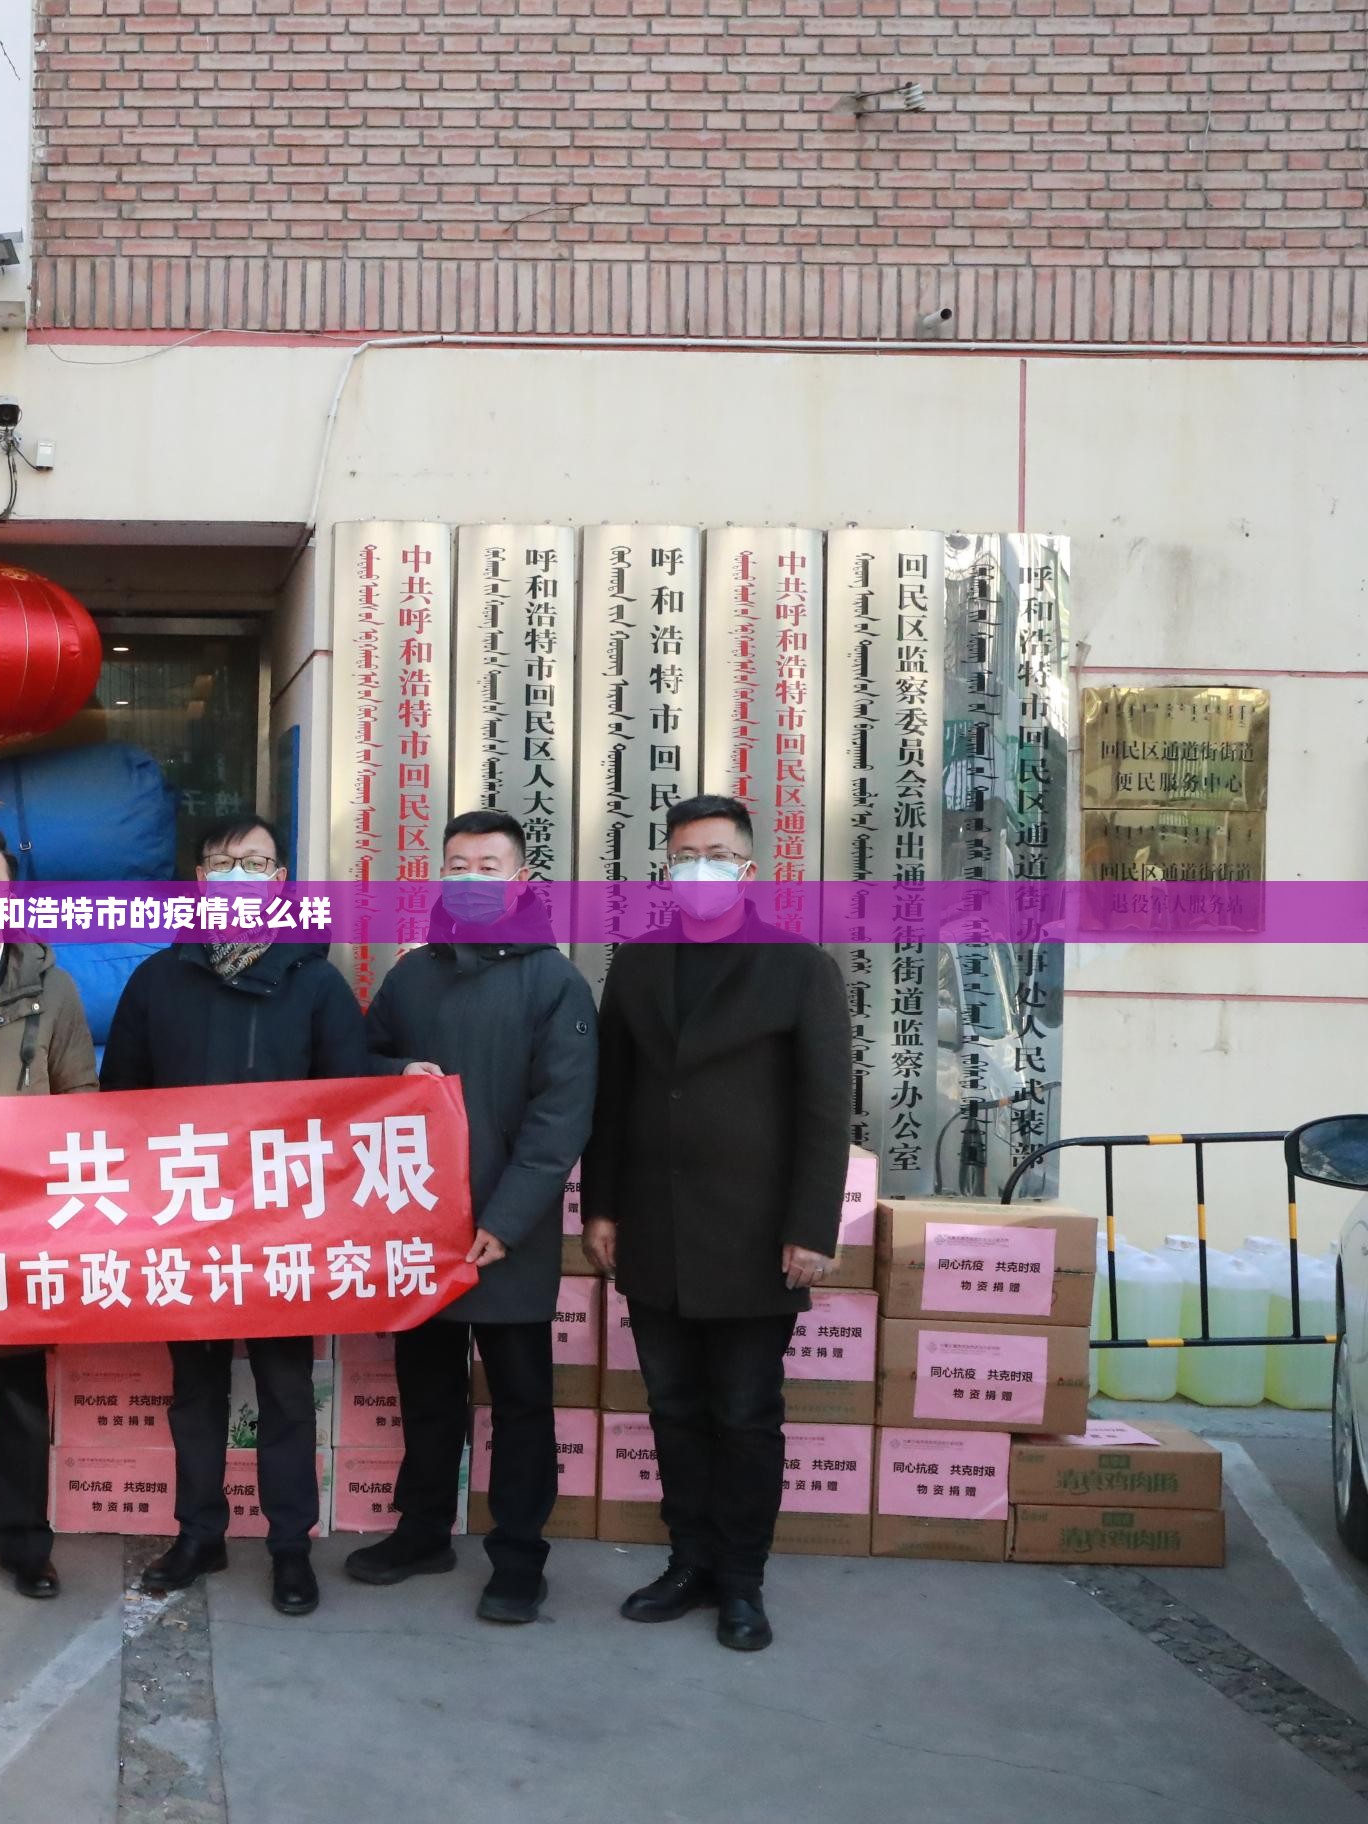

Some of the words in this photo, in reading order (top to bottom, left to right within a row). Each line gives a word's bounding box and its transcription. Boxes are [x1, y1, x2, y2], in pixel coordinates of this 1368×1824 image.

[1101, 740, 1255, 763] 回民区通道街街道
[1116, 771, 1243, 793] 便民服务中心
[888, 552, 929, 1171] 回民区监察委员会派出通道街街道监察办公室
[46, 1115, 440, 1230] 共克时艰
[938, 1258, 984, 1272] 同心抗疫
[995, 1261, 1041, 1274] 共克时艰
[961, 1280, 1021, 1293] 物资捐赠
[818, 1326, 862, 1338] 共克时艰
[930, 1366, 976, 1381] 同心抗疫
[987, 1368, 1033, 1382] 共克时艰
[74, 1394, 118, 1407] 同心抗疫
[353, 1395, 398, 1407] 同心抗疫
[953, 1388, 1013, 1402] 物资捐赠
[97, 1415, 155, 1427] 物资捐赠
[812, 1459, 857, 1472] 共克时艰
[892, 1461, 939, 1475] 同心抗疫
[950, 1464, 996, 1477] 共克时艰
[69, 1479, 113, 1492] 同心抗疫
[123, 1481, 168, 1494] 共克时艰
[348, 1482, 393, 1494] 同心抗疫
[916, 1483, 977, 1497] 物资捐赠
[92, 1501, 149, 1513] 物资捐赠
